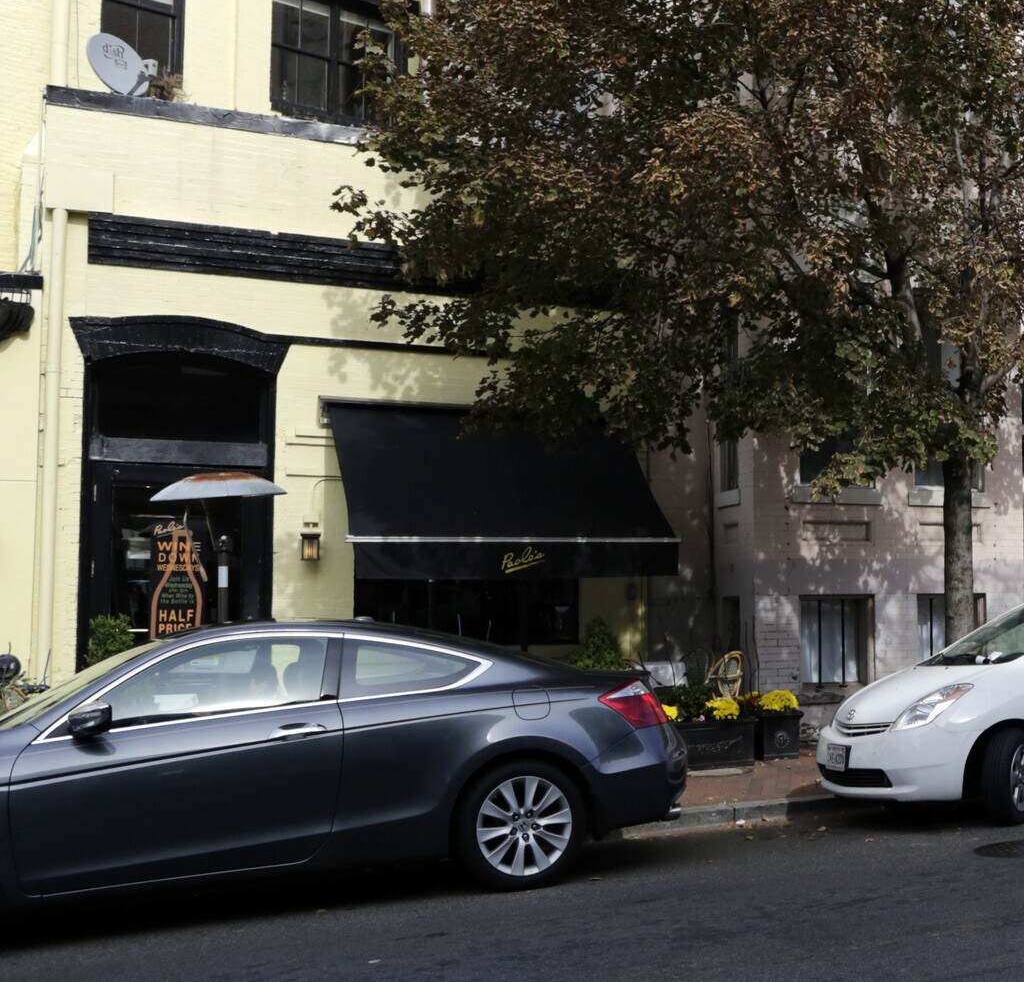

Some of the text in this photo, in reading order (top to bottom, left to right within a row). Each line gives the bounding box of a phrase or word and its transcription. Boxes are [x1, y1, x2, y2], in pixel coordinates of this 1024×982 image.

[157, 541, 201, 552] WINE
[501, 546, 545, 570] Paolo's
[159, 609, 194, 622] HALF
